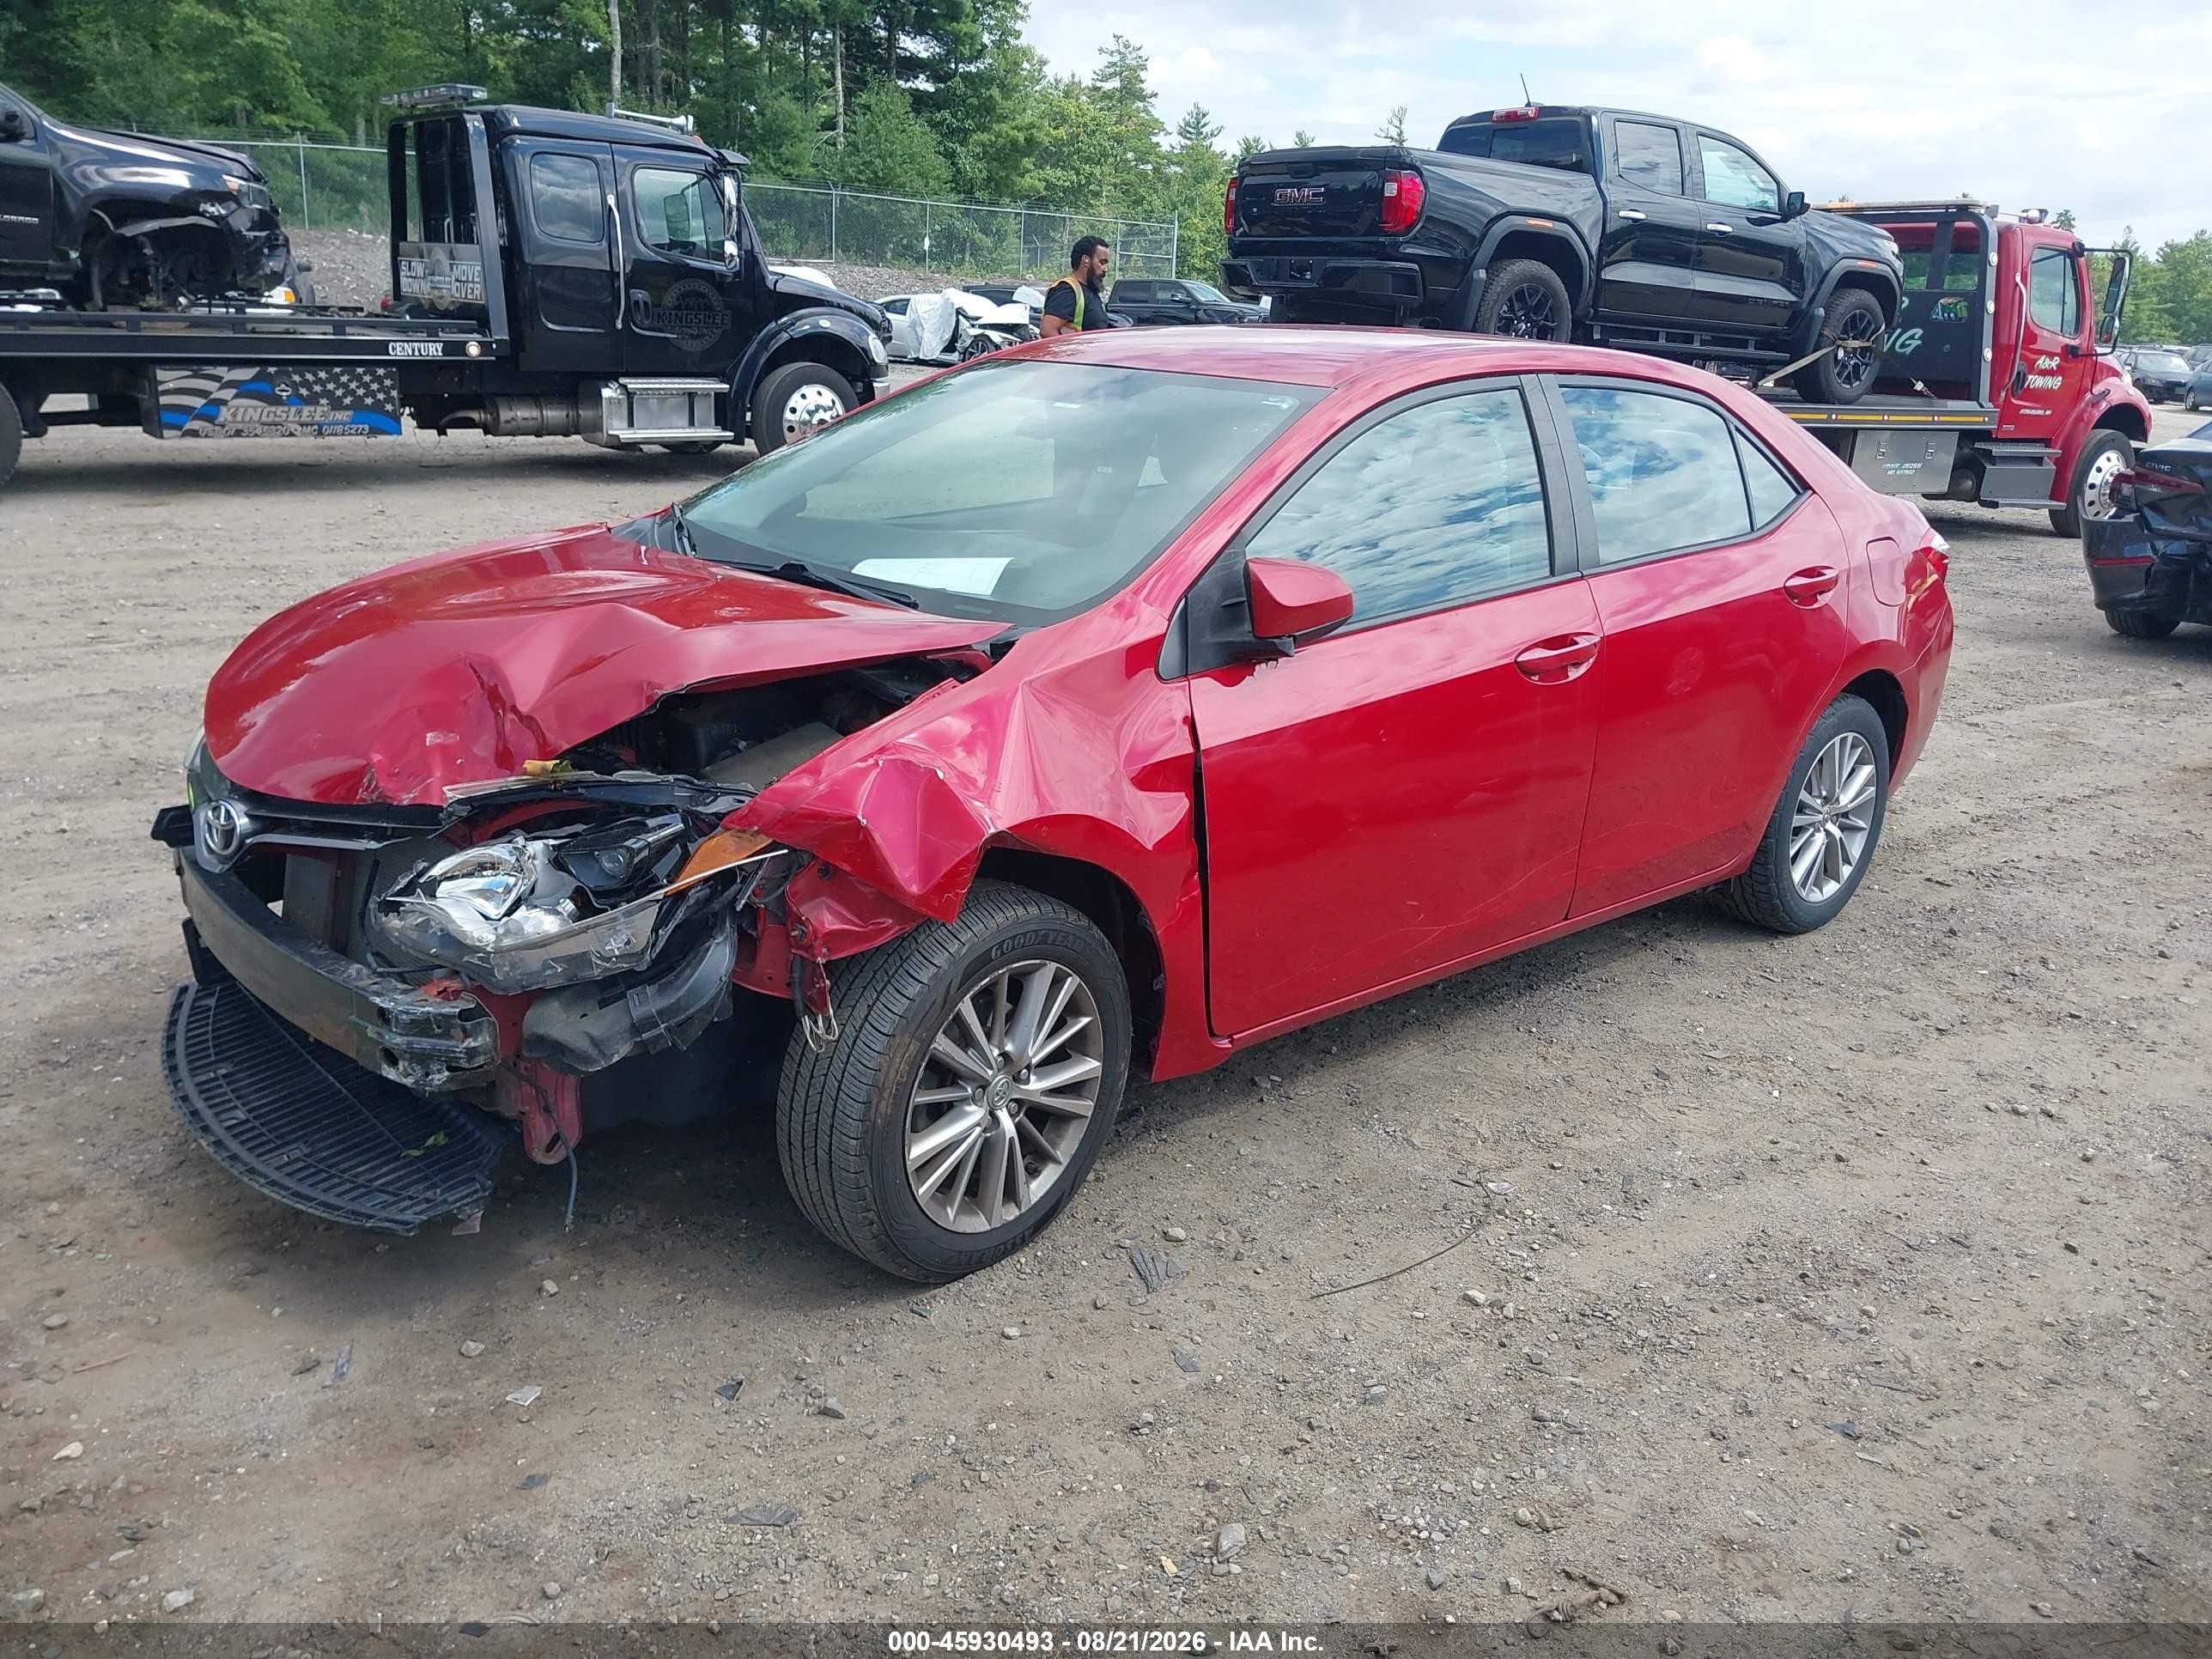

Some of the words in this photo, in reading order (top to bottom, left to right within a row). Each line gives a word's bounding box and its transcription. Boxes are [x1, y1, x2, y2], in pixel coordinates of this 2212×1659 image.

[1274, 187, 1325, 204] GMC
[401, 260, 425, 276] SLOW
[453, 264, 481, 283] MOVE
[402, 276, 427, 295] DOWN
[454, 282, 481, 301] OVER
[657, 310, 730, 326] KINGSLEE
[388, 342, 444, 356] CENTURY
[2034, 356, 2060, 371] A&R
[2024, 374, 2063, 390] TOWING
[216, 405, 331, 423] KINGSLEE
[330, 410, 353, 422] INC
[301, 425, 319, 435] MC
[322, 424, 370, 436] 01185273
[2145, 462, 2172, 471] CIVIC
[991, 930, 1086, 960] GOODYEAR
